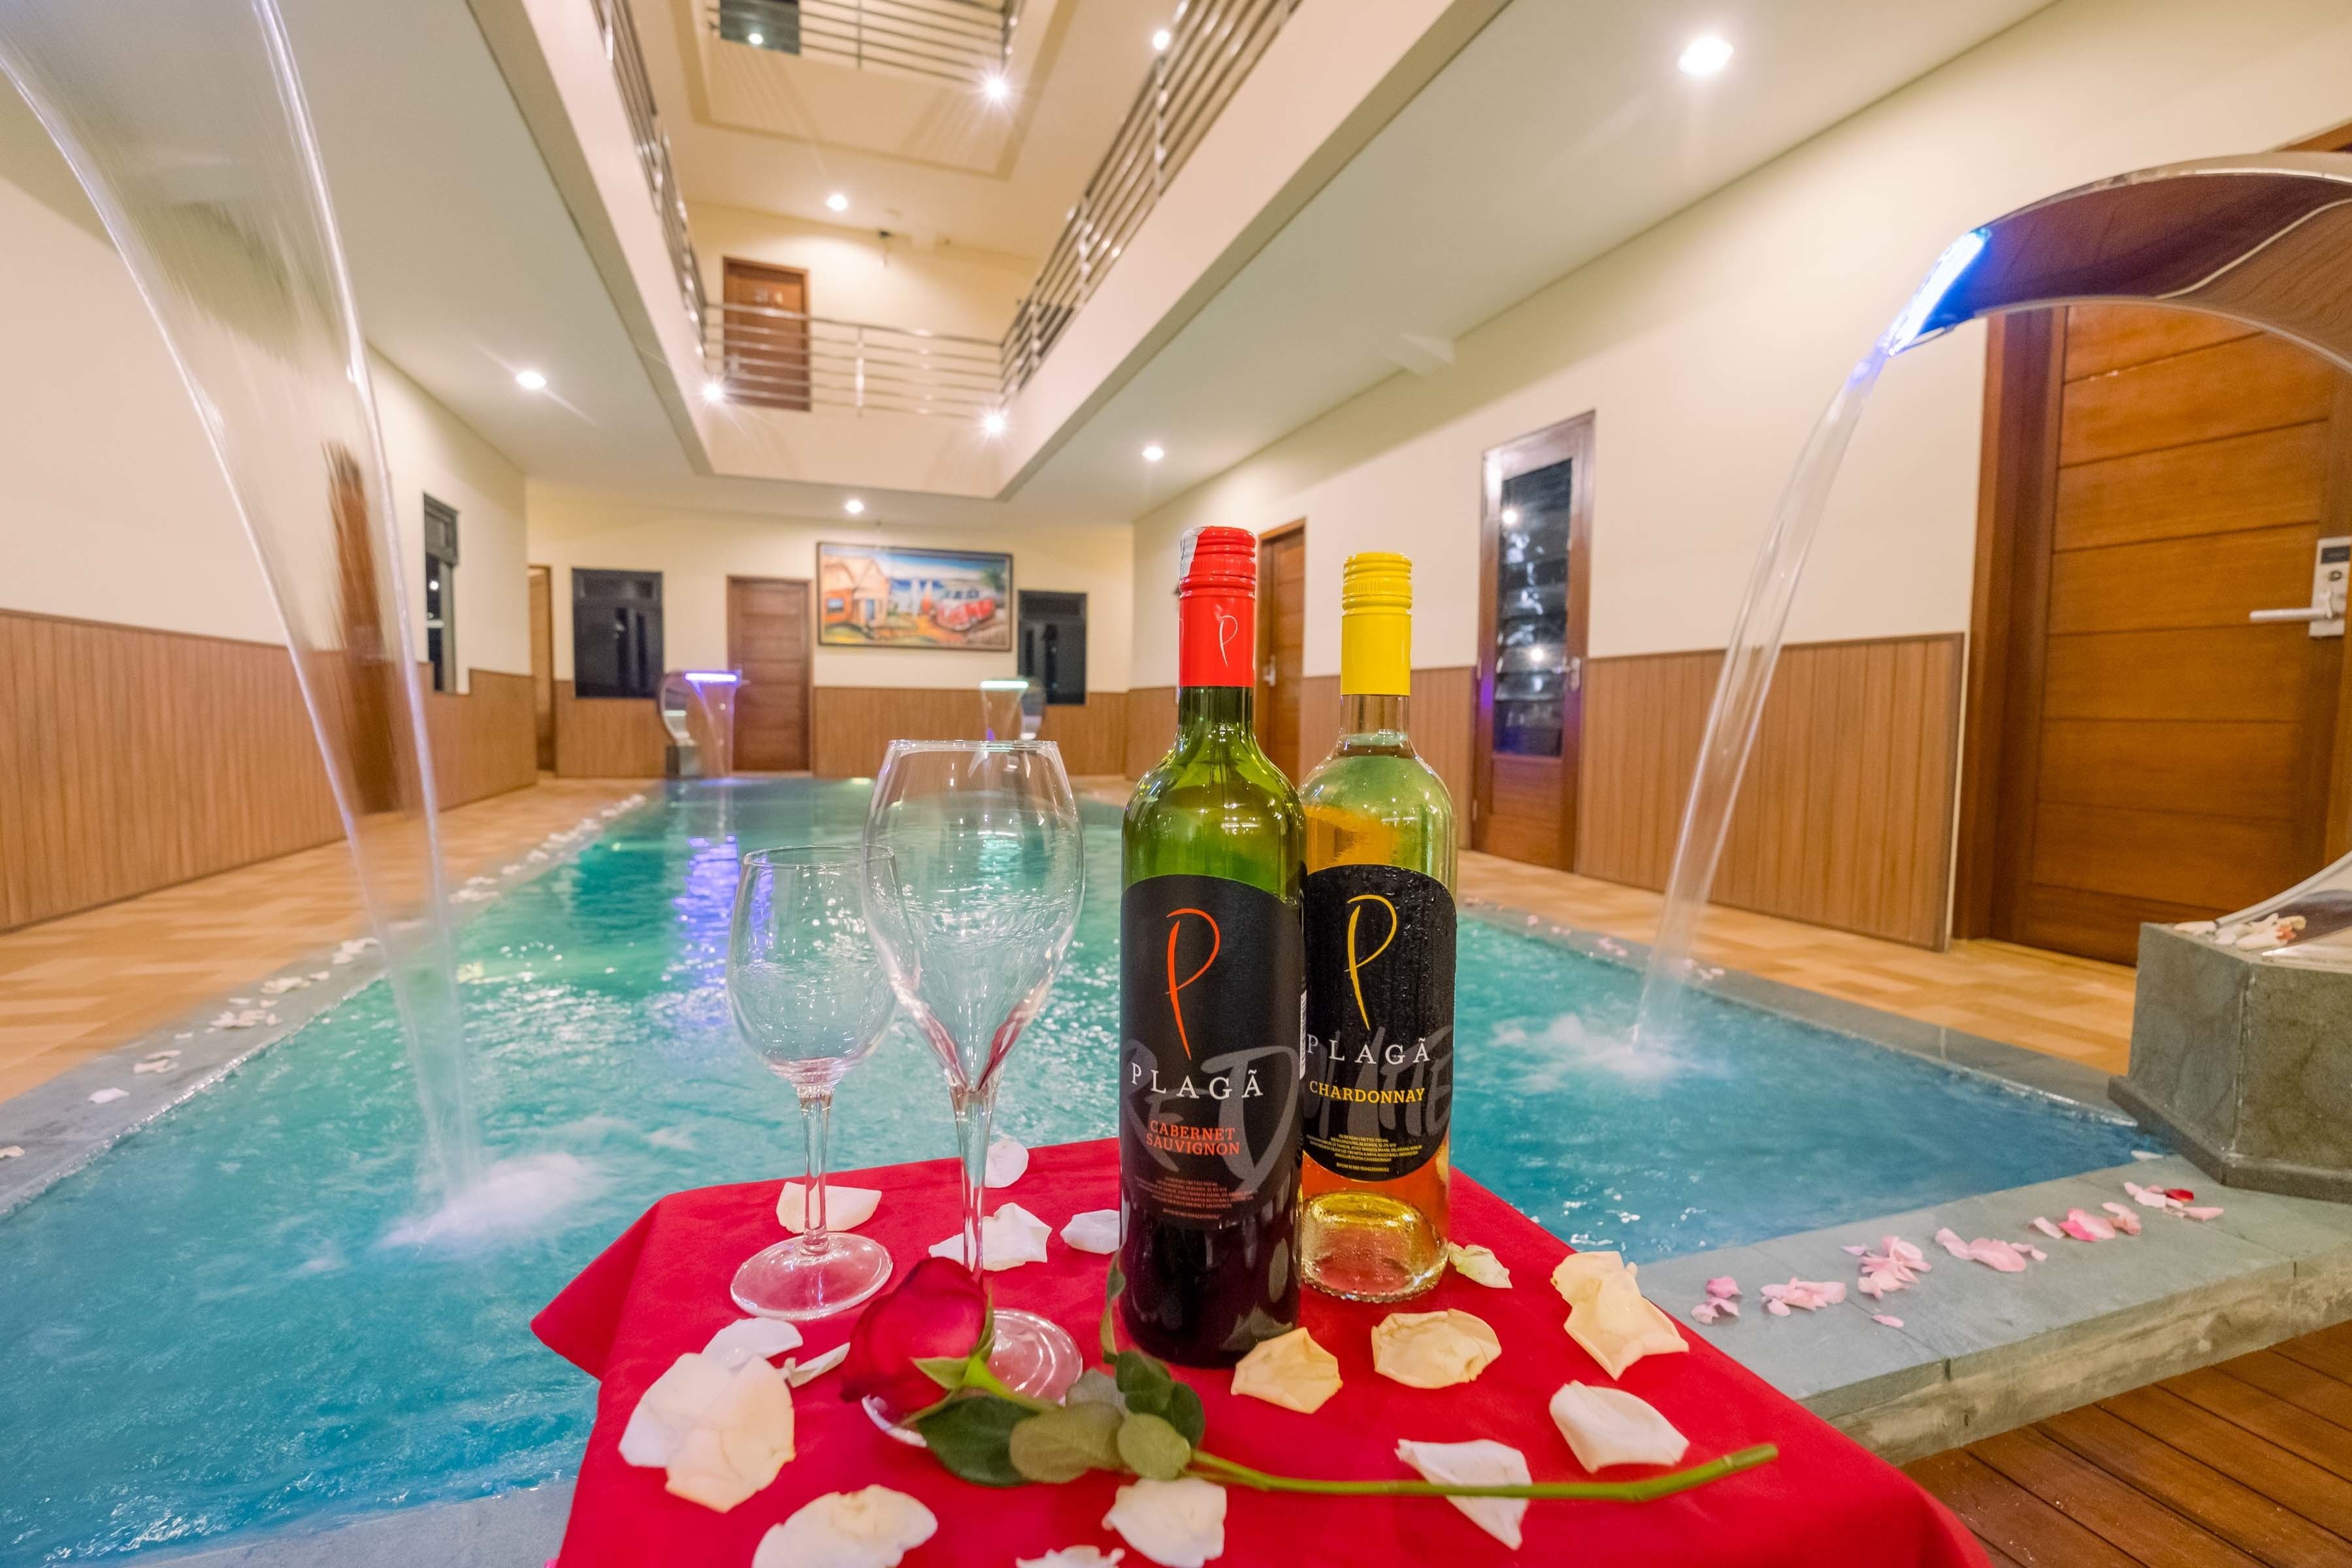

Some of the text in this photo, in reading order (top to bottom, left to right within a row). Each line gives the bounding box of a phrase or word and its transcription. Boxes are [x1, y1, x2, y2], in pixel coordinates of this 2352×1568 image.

[1344, 894, 1397, 1031] P
[1165, 907, 1221, 1060] P
[1307, 1034, 1430, 1065] PLAGÃ
[1131, 1062, 1264, 1100] PLAGÃ
[1309, 1081, 1426, 1103] CHARDONNAY
[1146, 1134, 1240, 1156] SAUVIGNON
[1149, 1120, 1235, 1141] CABERNET
